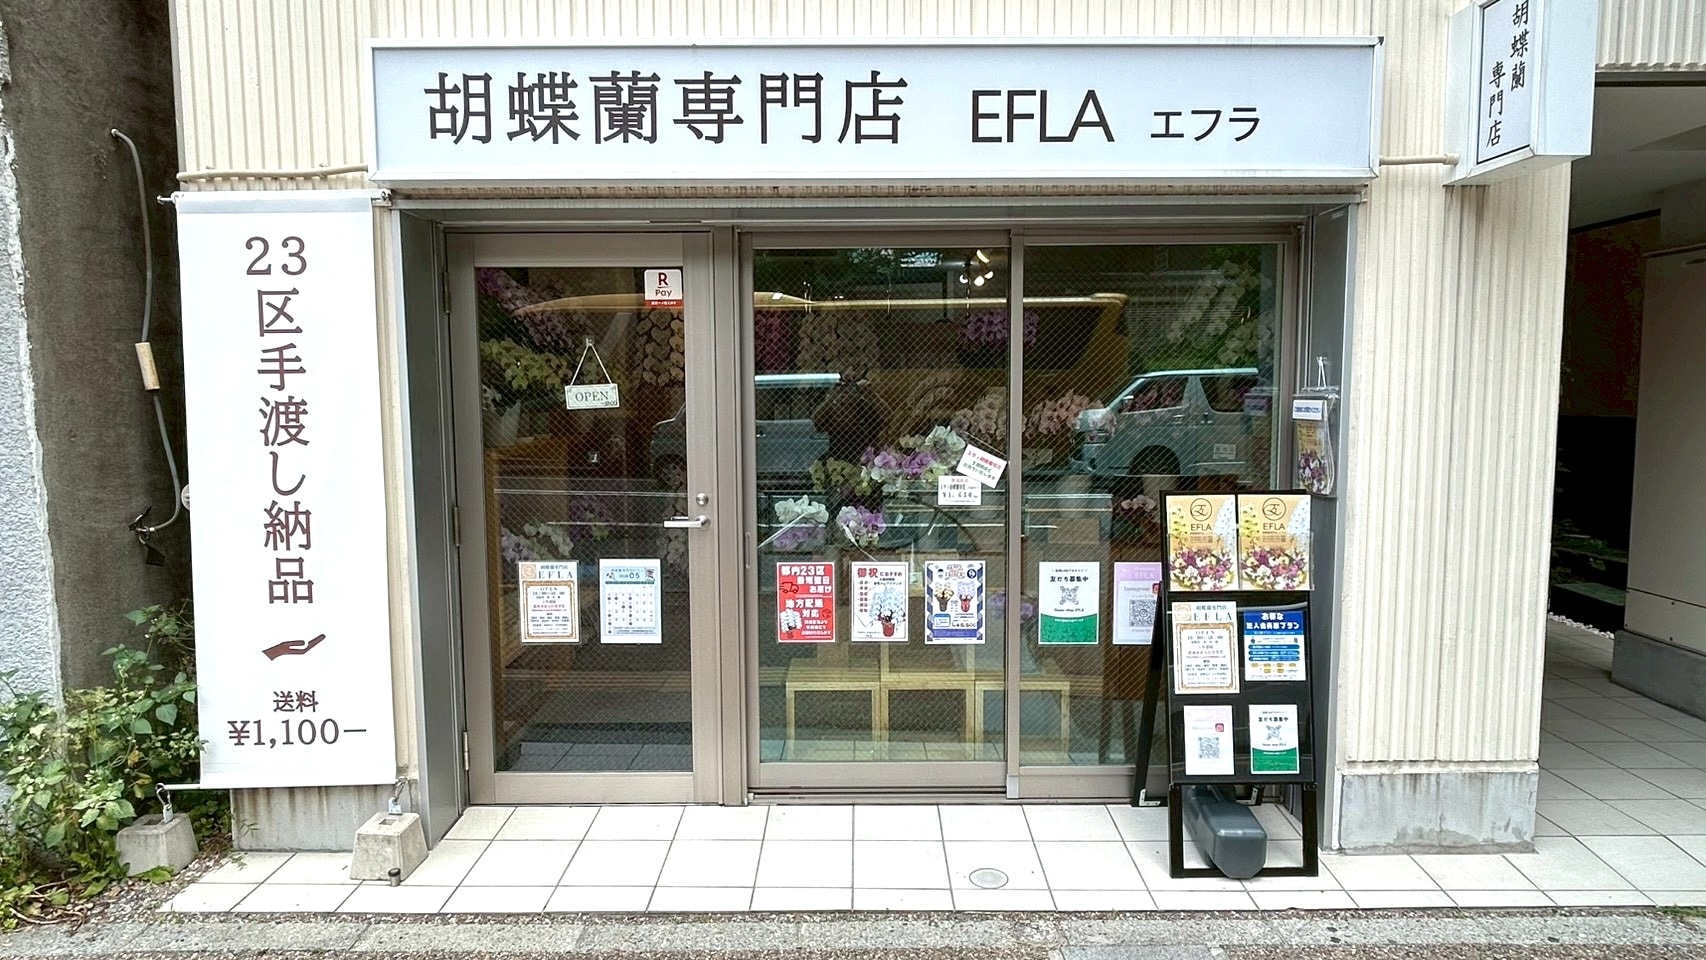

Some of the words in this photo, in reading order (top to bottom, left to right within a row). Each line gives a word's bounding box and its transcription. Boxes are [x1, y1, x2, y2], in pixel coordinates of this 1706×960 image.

[1509, 0, 1530, 92] 胡蝶蘭
[423, 69, 908, 145] 胡蝶蘭専門店
[971, 89, 1116, 143] EFLA
[1150, 107, 1260, 142] エフラ
[1486, 61, 1506, 148] 専門店
[658, 272, 669, 286] R
[655, 289, 673, 298] Pay
[575, 390, 609, 402] OPEN
[245, 236, 314, 604] 23区手渡し納品
[1190, 523, 1212, 531] EFLA
[1262, 522, 1286, 530] EFLA
[538, 571, 573, 579] EFLA
[781, 565, 825, 576] 都内23区
[802, 609, 819, 618] 対応
[1193, 611, 1232, 621] EFLA
[272, 690, 319, 713] 送料
